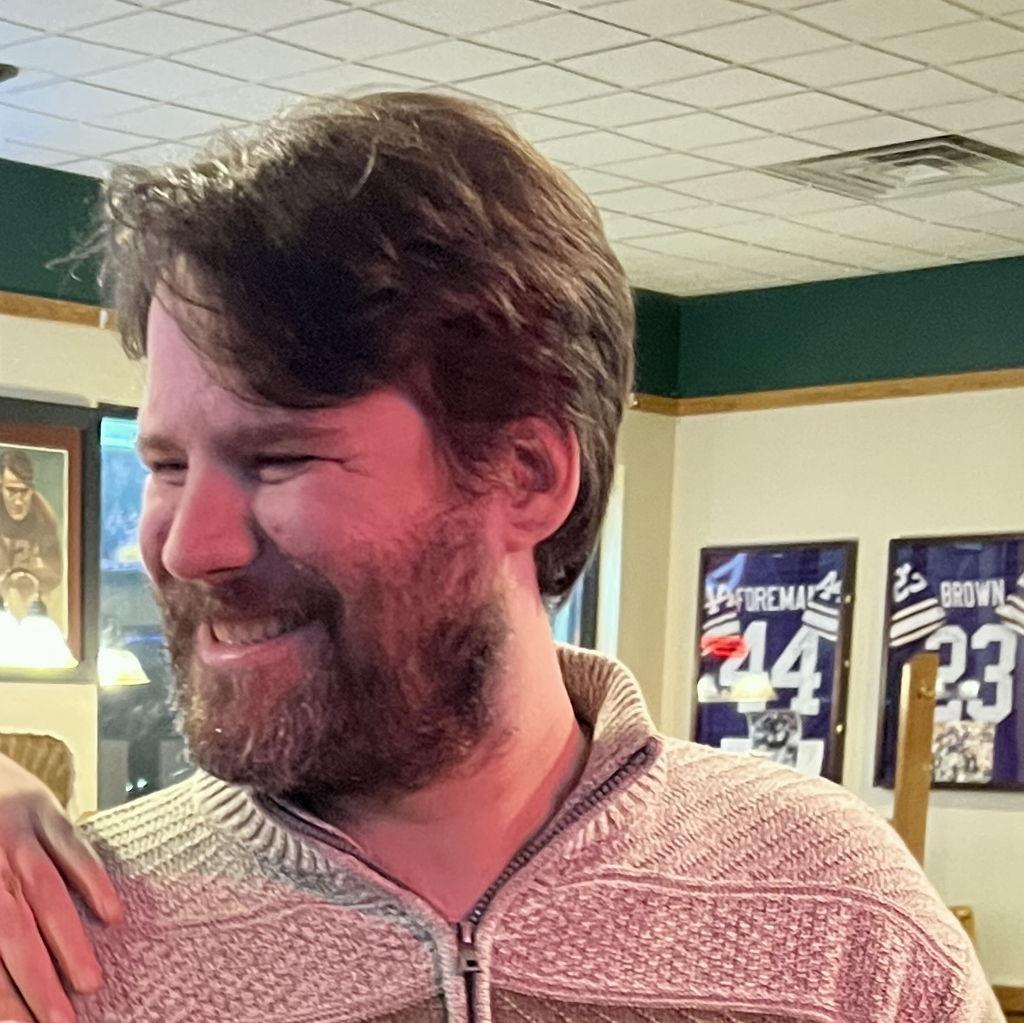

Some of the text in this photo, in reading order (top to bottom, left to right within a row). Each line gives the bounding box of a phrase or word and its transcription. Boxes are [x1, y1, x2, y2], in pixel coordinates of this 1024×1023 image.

[939, 579, 1006, 608] BROWN
[719, 620, 822, 716] 44
[924, 622, 1018, 725] 23
